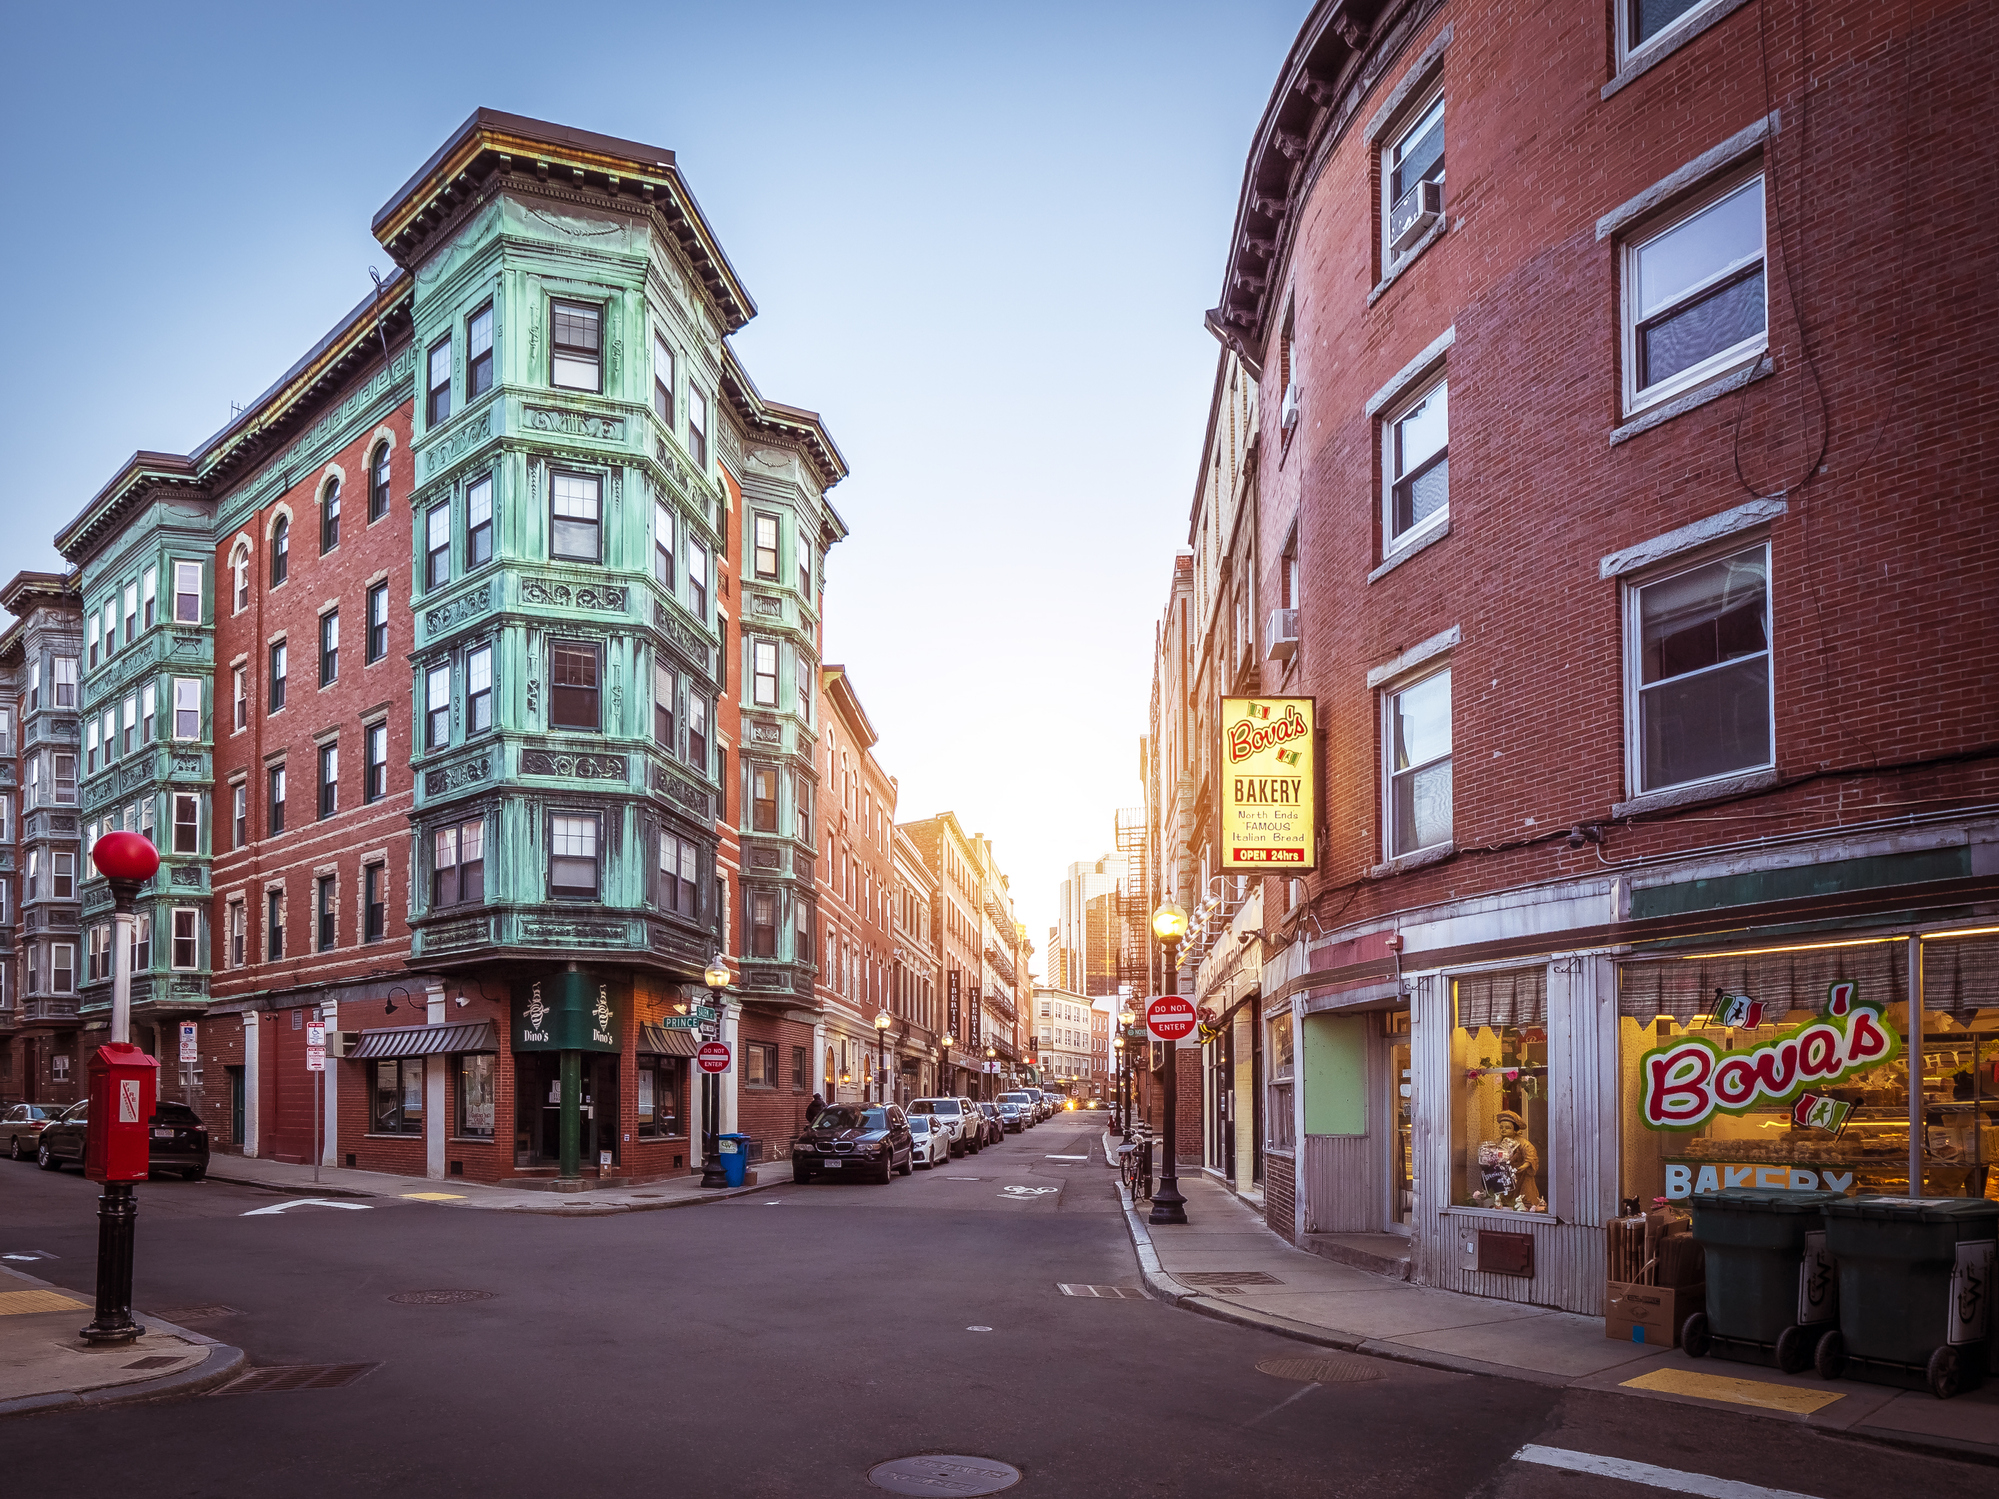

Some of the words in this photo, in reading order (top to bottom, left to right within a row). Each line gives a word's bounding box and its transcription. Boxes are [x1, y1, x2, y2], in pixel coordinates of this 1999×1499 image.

[1229, 705, 1307, 764] Bova's
[1234, 778, 1302, 803] BAKERY
[1238, 810, 1268, 820] North
[1232, 832, 1267, 842] Italian
[1273, 832, 1305, 842] Bread
[1240, 849, 1267, 861] OPEN
[1271, 849, 1299, 861] 24hrs
[950, 972, 958, 1037] LIBERTINE
[1154, 1005, 1167, 1013] DO
[1170, 1004, 1187, 1012] NOT
[666, 1018, 697, 1027] PRINCE
[1158, 1023, 1186, 1032] ENTER
[524, 1029, 549, 1043] Dino's
[592, 1028, 613, 1045] Dino's
[1640, 981, 1897, 1131] Bova's
[125, 1082, 136, 1102] FIRE
